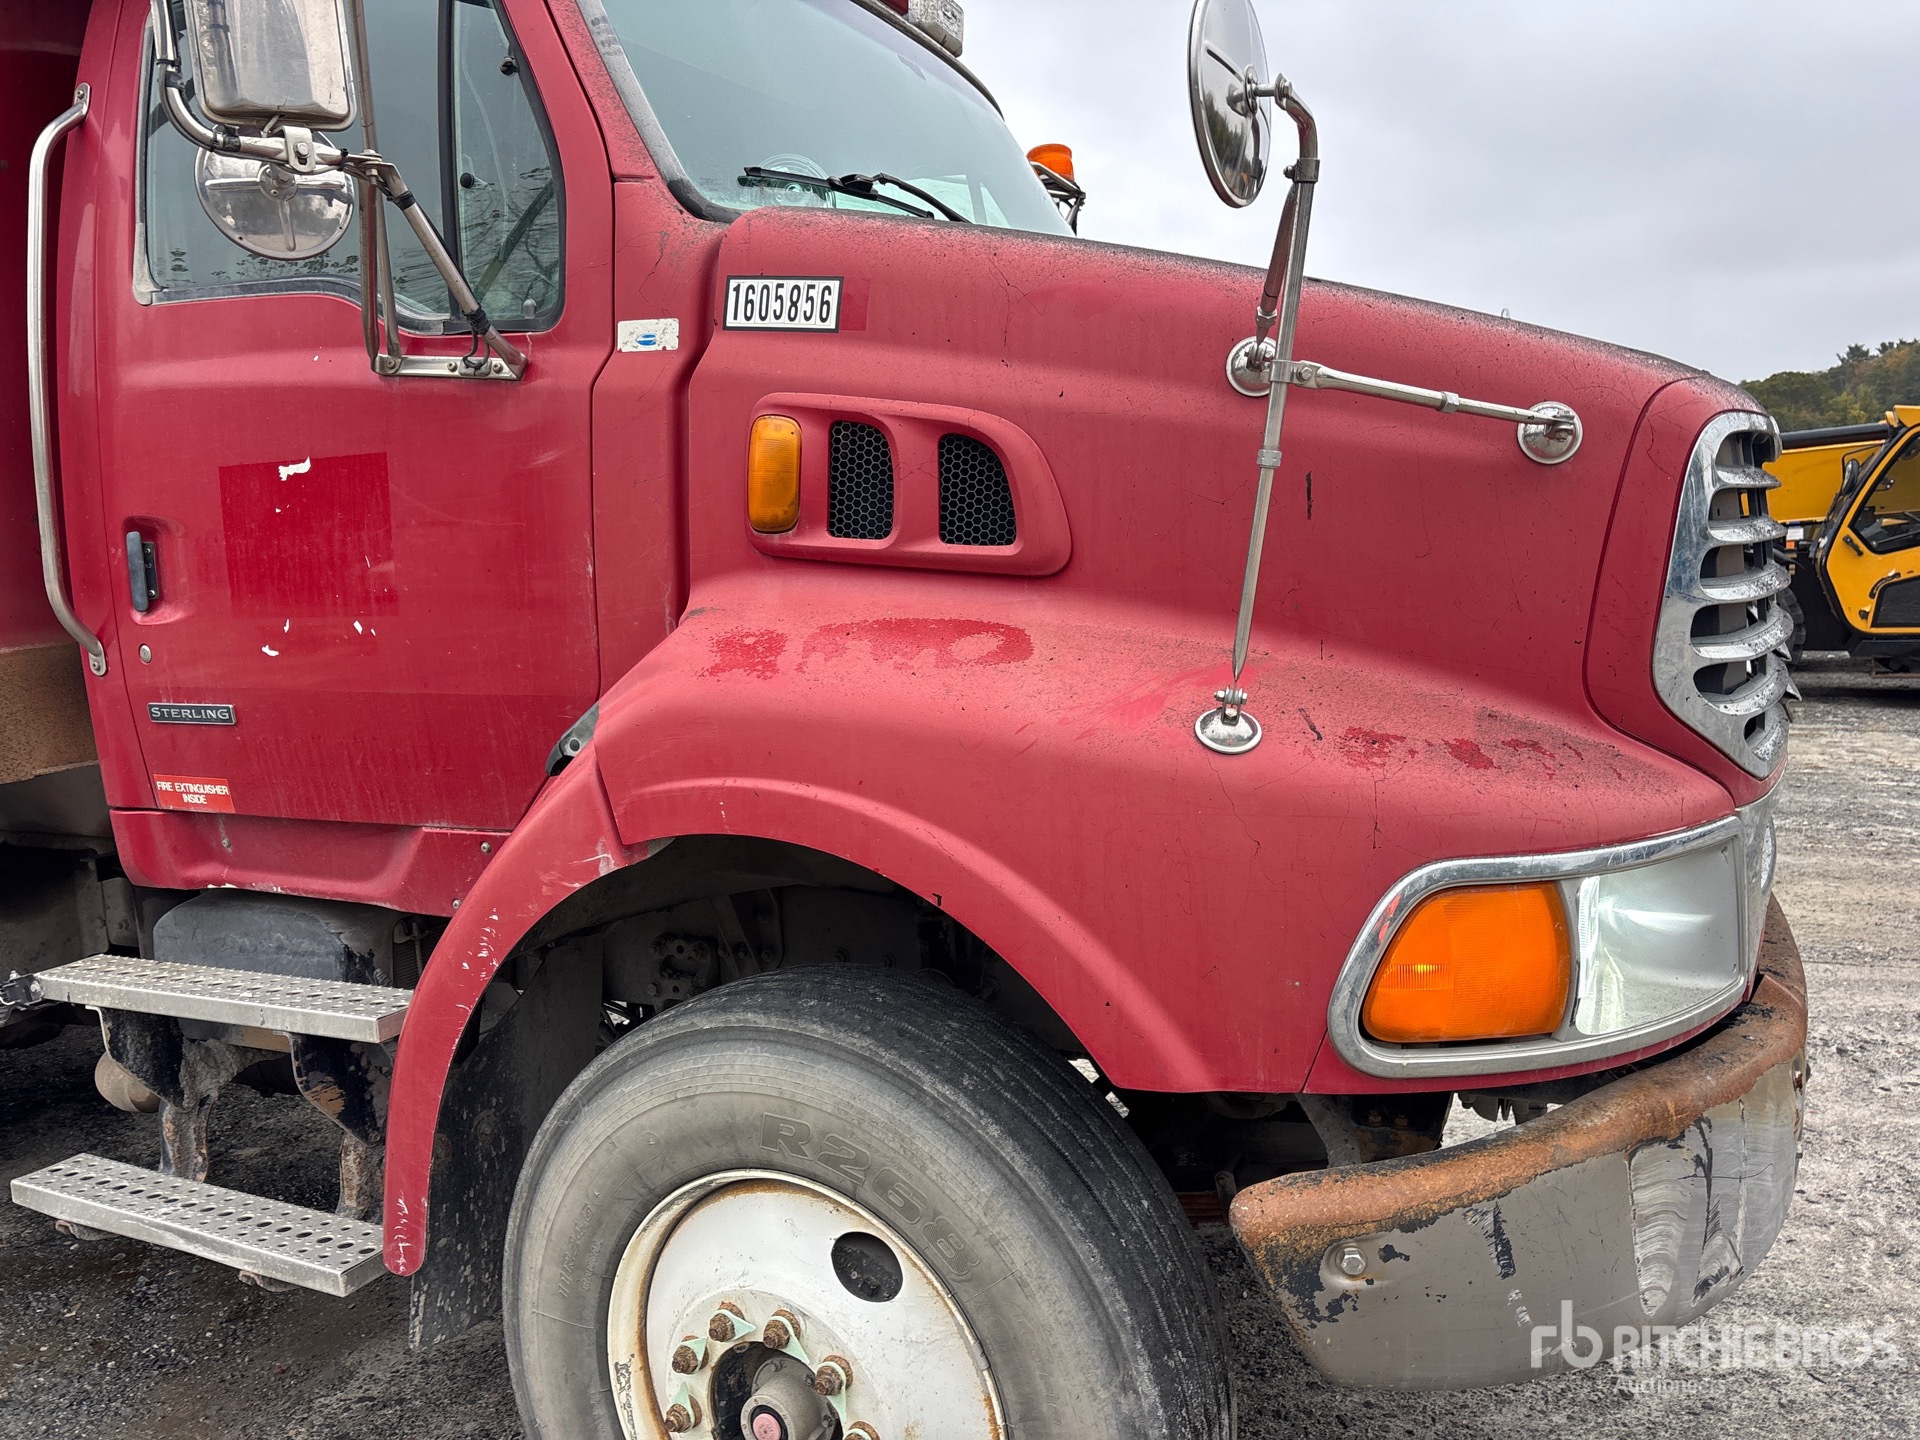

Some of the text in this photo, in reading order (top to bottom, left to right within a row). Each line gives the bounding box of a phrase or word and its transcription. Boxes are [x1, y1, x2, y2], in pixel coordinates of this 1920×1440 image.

[733, 283, 832, 323] 1605856
[151, 707, 229, 719] STERLING
[156, 781, 229, 795] FIRE EXTINGUISHER
[182, 794, 207, 804] INSIDE
[760, 1111, 981, 1276] R268
